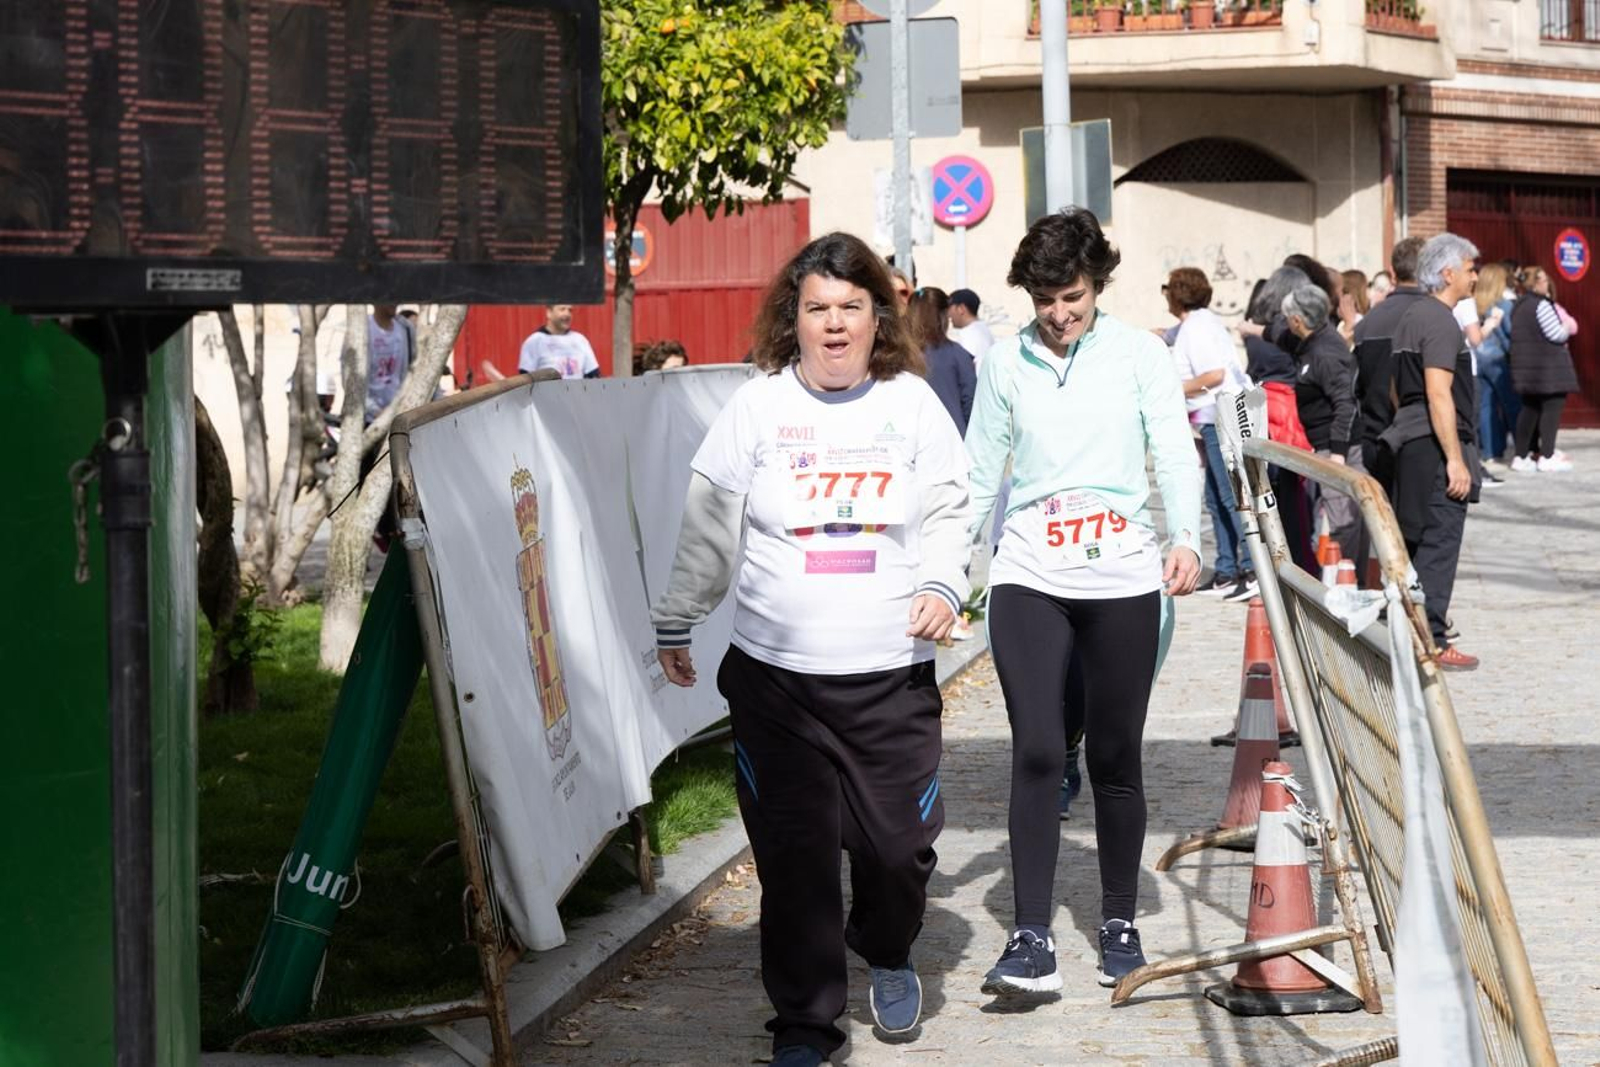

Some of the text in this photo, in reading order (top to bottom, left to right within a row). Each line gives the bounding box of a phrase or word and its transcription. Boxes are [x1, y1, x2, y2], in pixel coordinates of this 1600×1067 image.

[777, 424, 816, 440] XXVII
[1235, 393, 1254, 441] tamie
[795, 471, 893, 501] 5777
[1047, 510, 1127, 547] 5779
[287, 852, 350, 902] Jun
